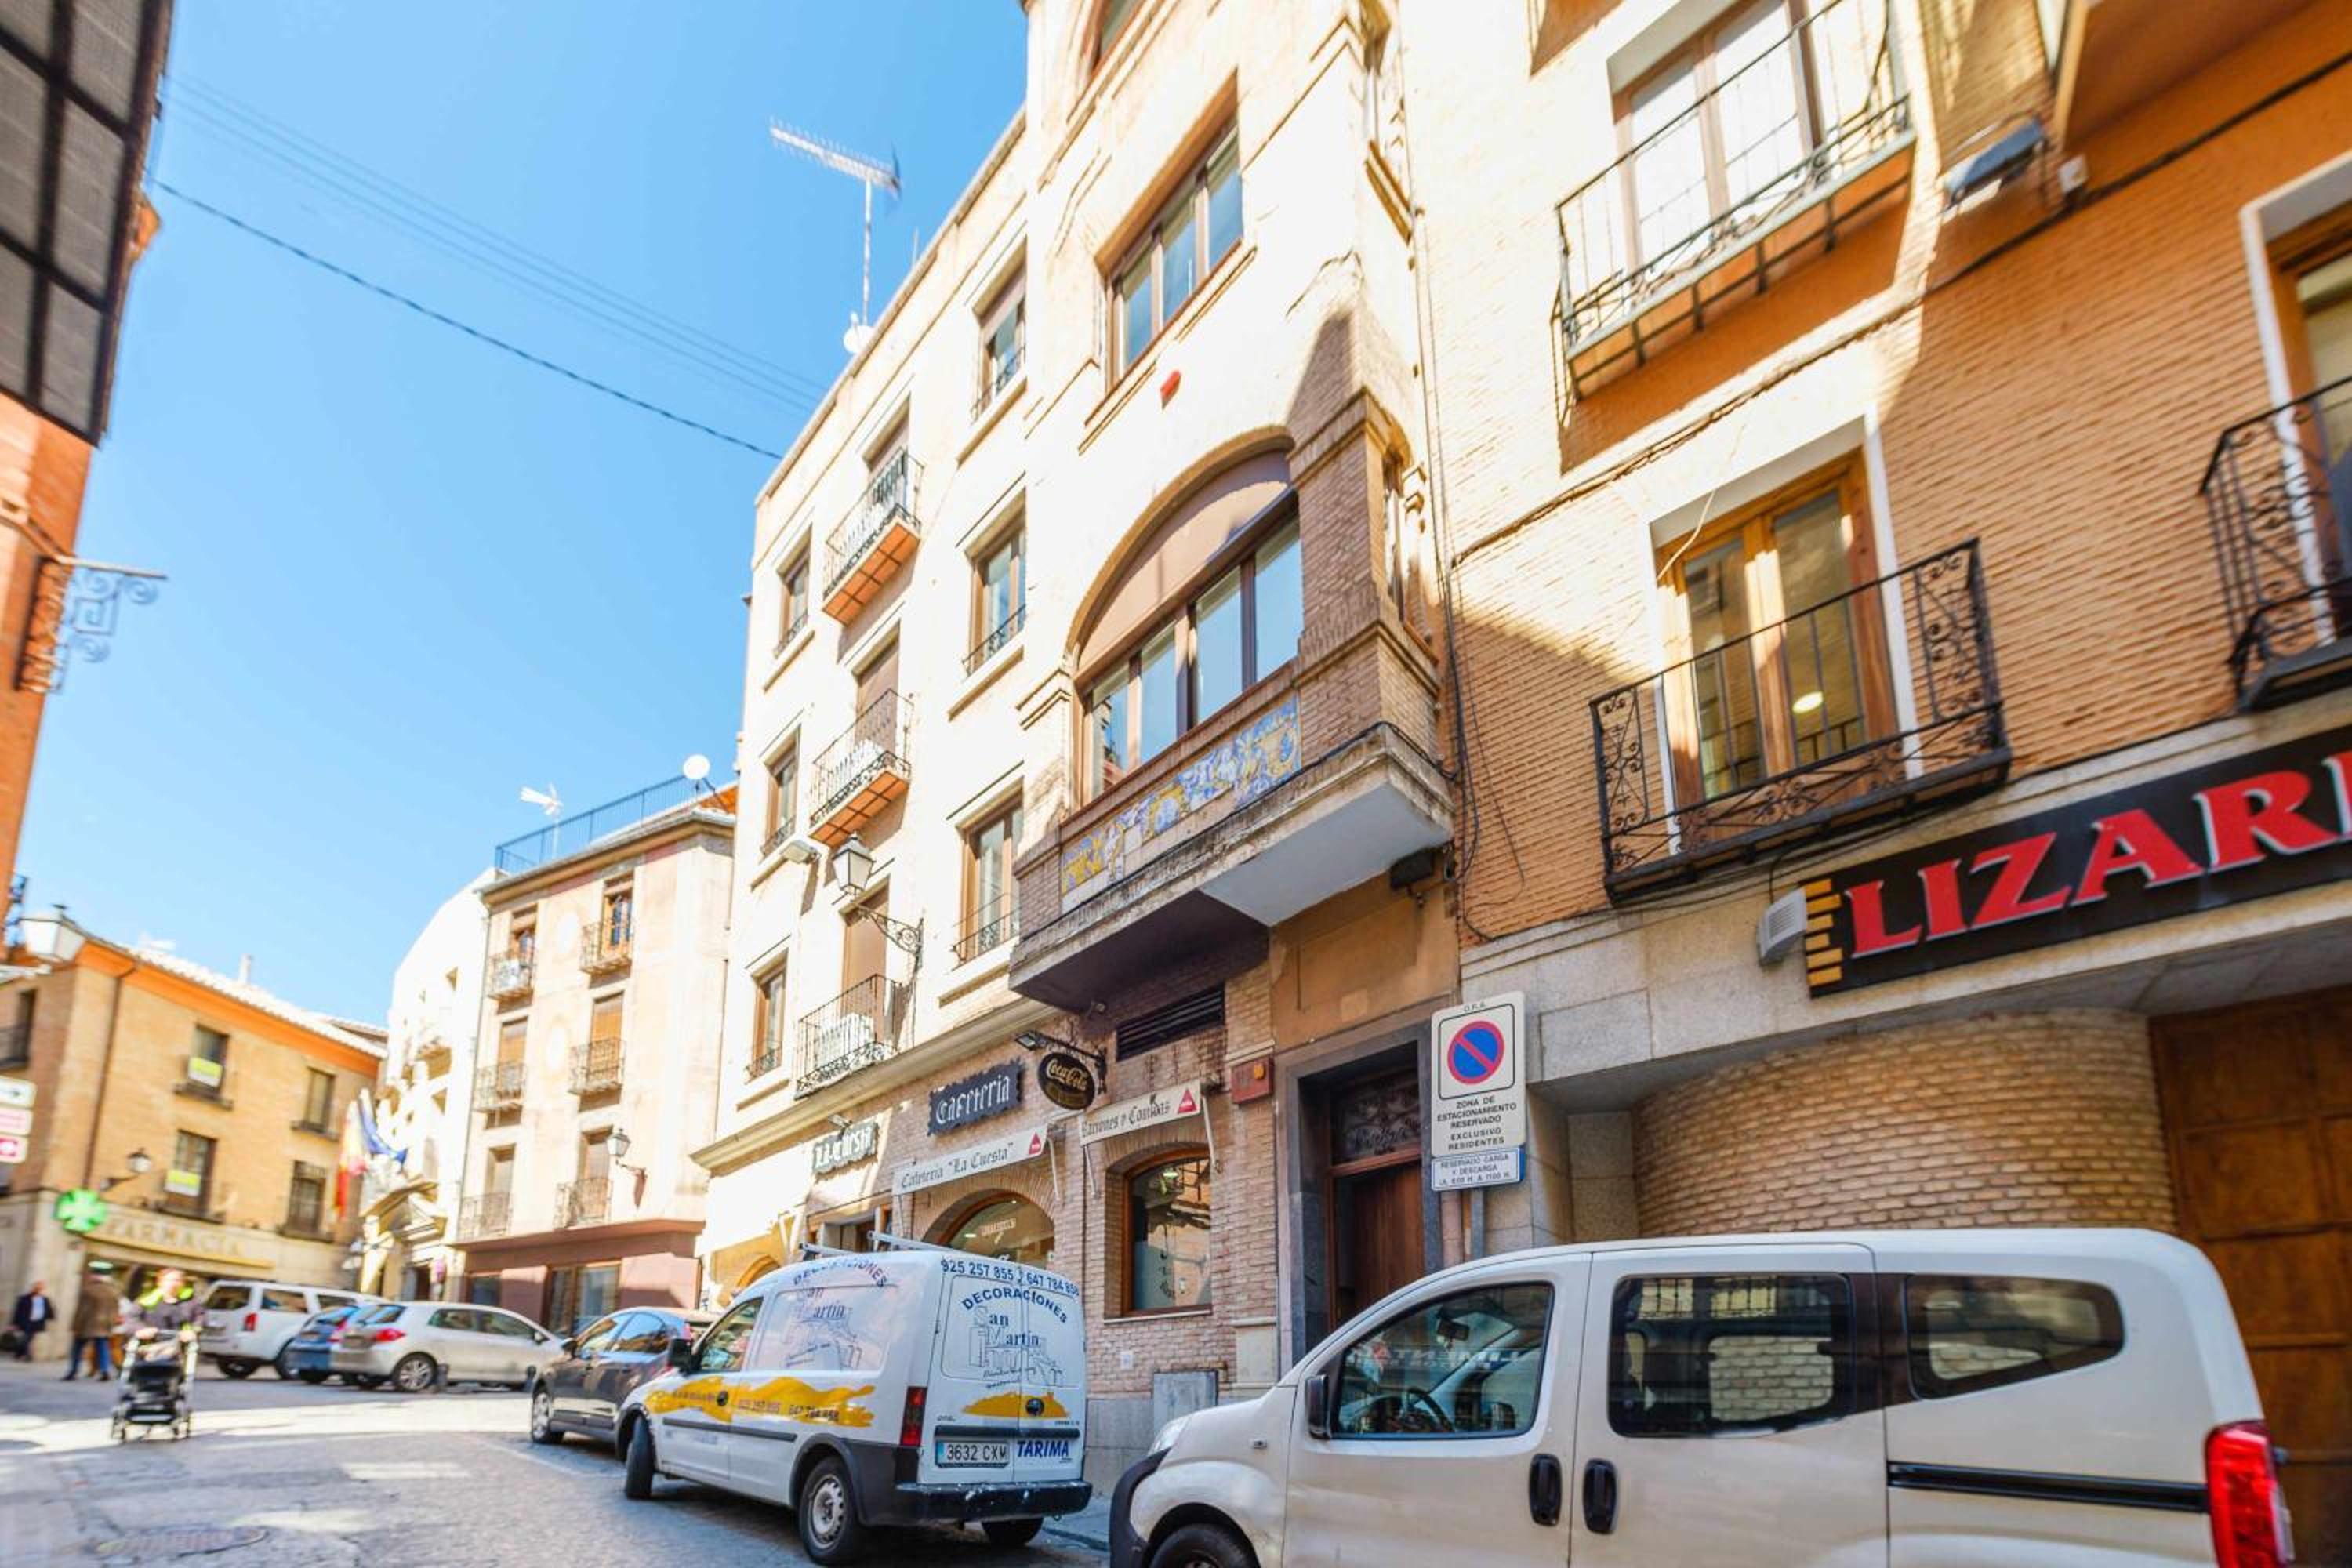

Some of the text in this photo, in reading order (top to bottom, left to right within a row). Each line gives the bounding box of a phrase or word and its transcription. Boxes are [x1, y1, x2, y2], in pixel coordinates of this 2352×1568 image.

[1845, 750, 2352, 959] LIZAR
[1456, 1095, 1495, 1109] ZONA DE
[1437, 1102, 1517, 1122] ESTACIONAMIENTO
[1450, 1114, 1501, 1128] RESERVADO
[1448, 1136, 1504, 1150] RESIDENTES
[1450, 1127, 1501, 1141] EXCLUSIVO
[793, 1258, 887, 1287] DECCIONES
[941, 1258, 965, 1273] 925
[969, 1261, 989, 1276] 257
[994, 1266, 1014, 1281] 855
[1026, 1272, 1044, 1287] 647
[1047, 1277, 1063, 1290] 784
[962, 1287, 1068, 1324] DECORACIONES
[975, 1305, 1010, 1327] San
[946, 1444, 978, 1461] 3632
[1017, 1440, 1069, 1458] TARIMA
